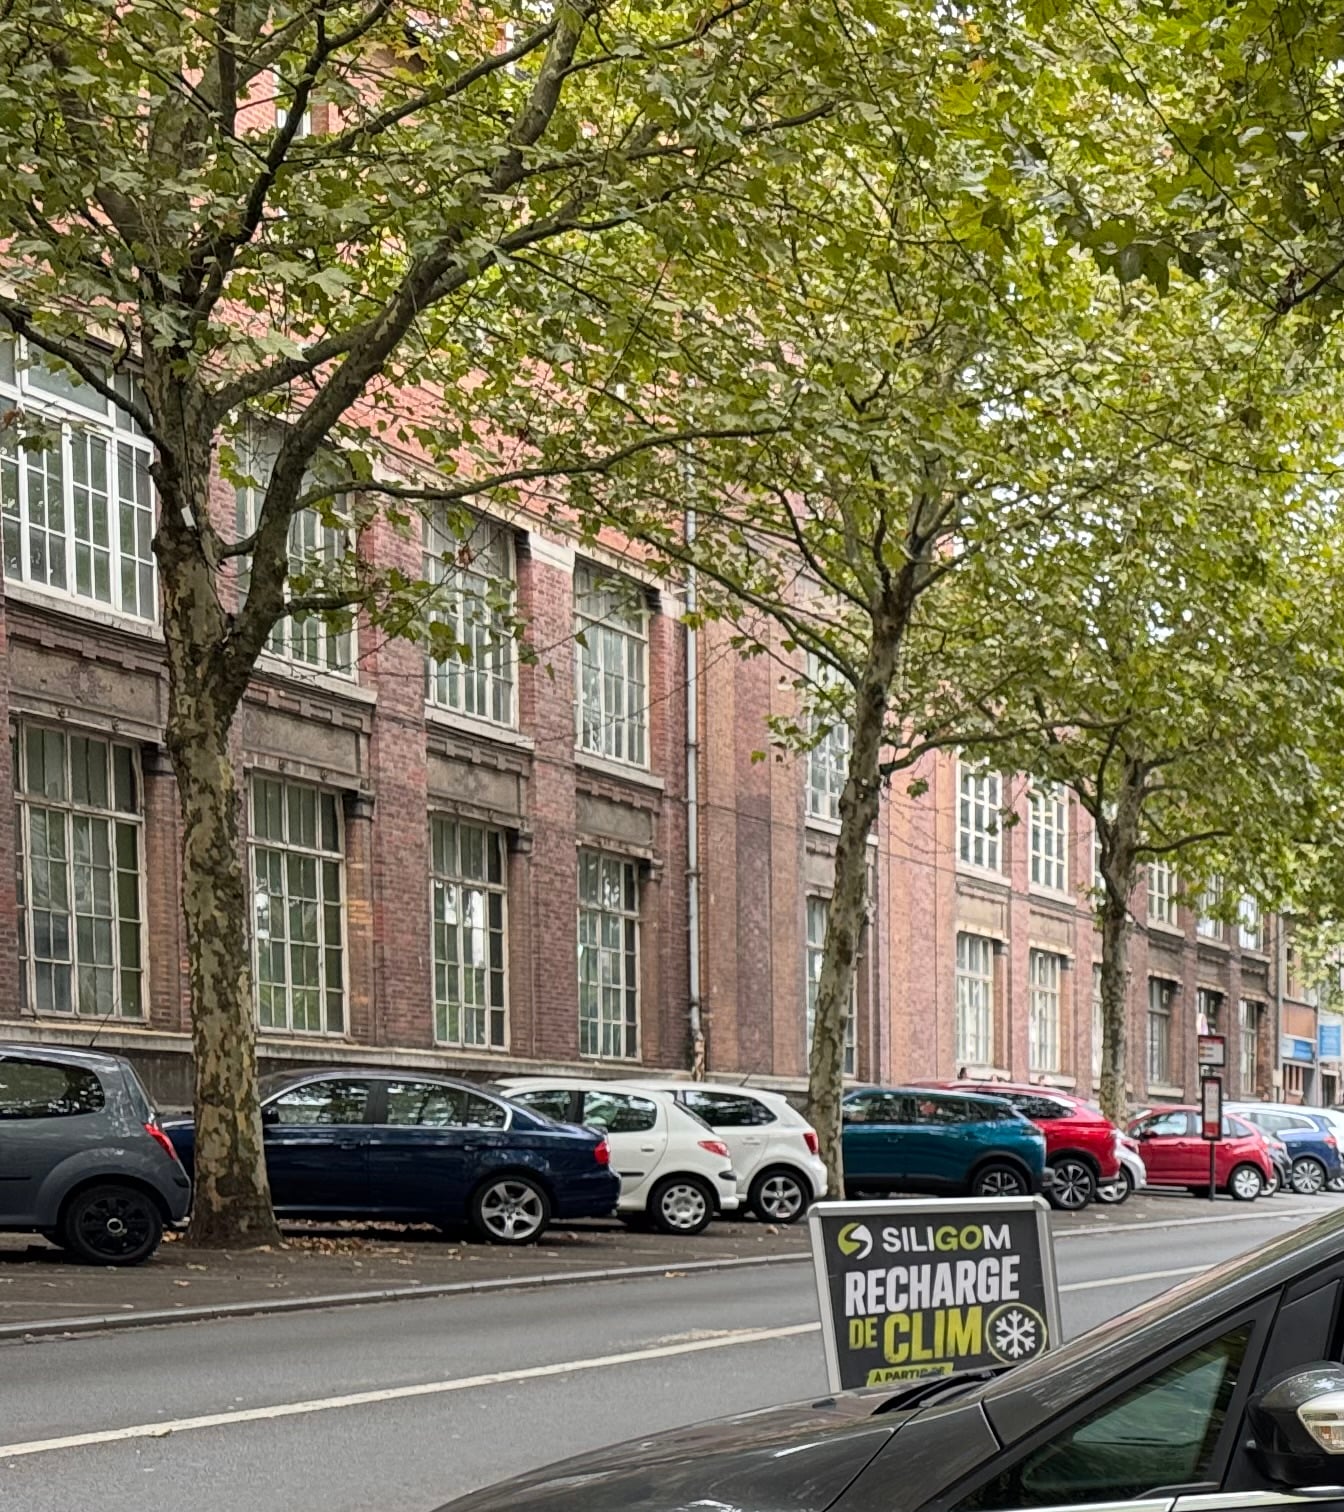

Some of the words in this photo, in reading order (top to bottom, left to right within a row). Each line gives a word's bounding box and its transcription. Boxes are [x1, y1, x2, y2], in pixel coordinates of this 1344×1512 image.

[882, 1224, 1011, 1252] SILIGOM
[845, 1255, 1021, 1317] RECHARGE
[849, 1317, 878, 1349] DE
[884, 1306, 983, 1364] CLIM
